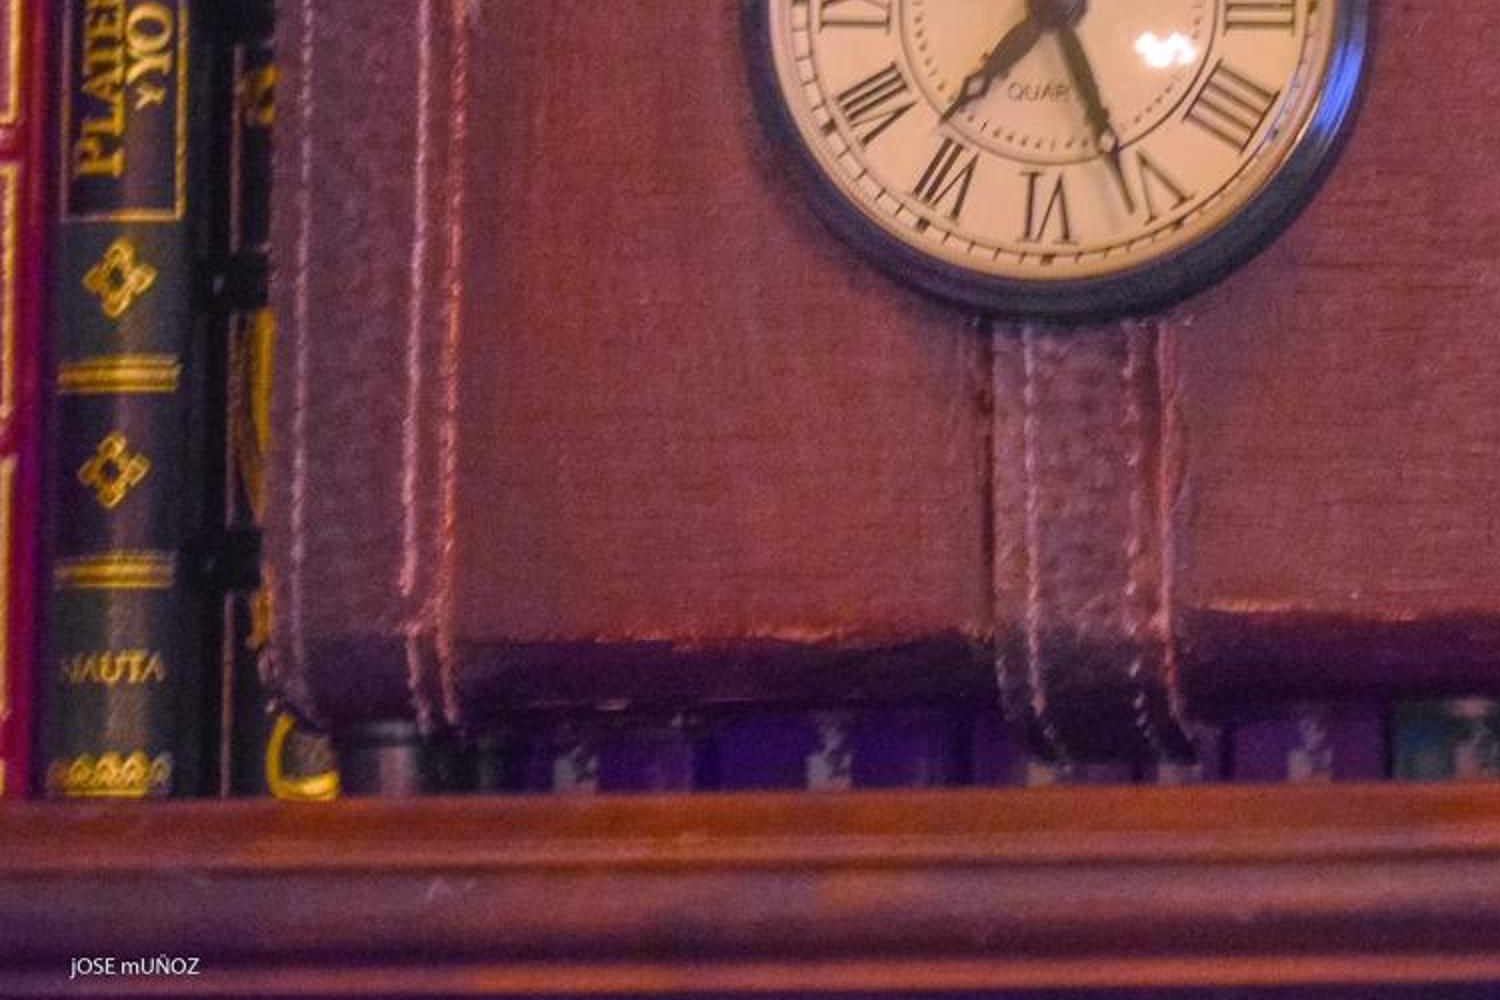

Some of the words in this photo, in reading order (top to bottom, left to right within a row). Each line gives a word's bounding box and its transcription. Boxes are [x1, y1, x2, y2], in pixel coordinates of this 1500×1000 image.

[126, 1, 173, 85] YO
[835, 62, 918, 146] VIII
[1007, 81, 1076, 103] QUAR
[910, 138, 980, 220] VII
[1018, 171, 1079, 244] VI
